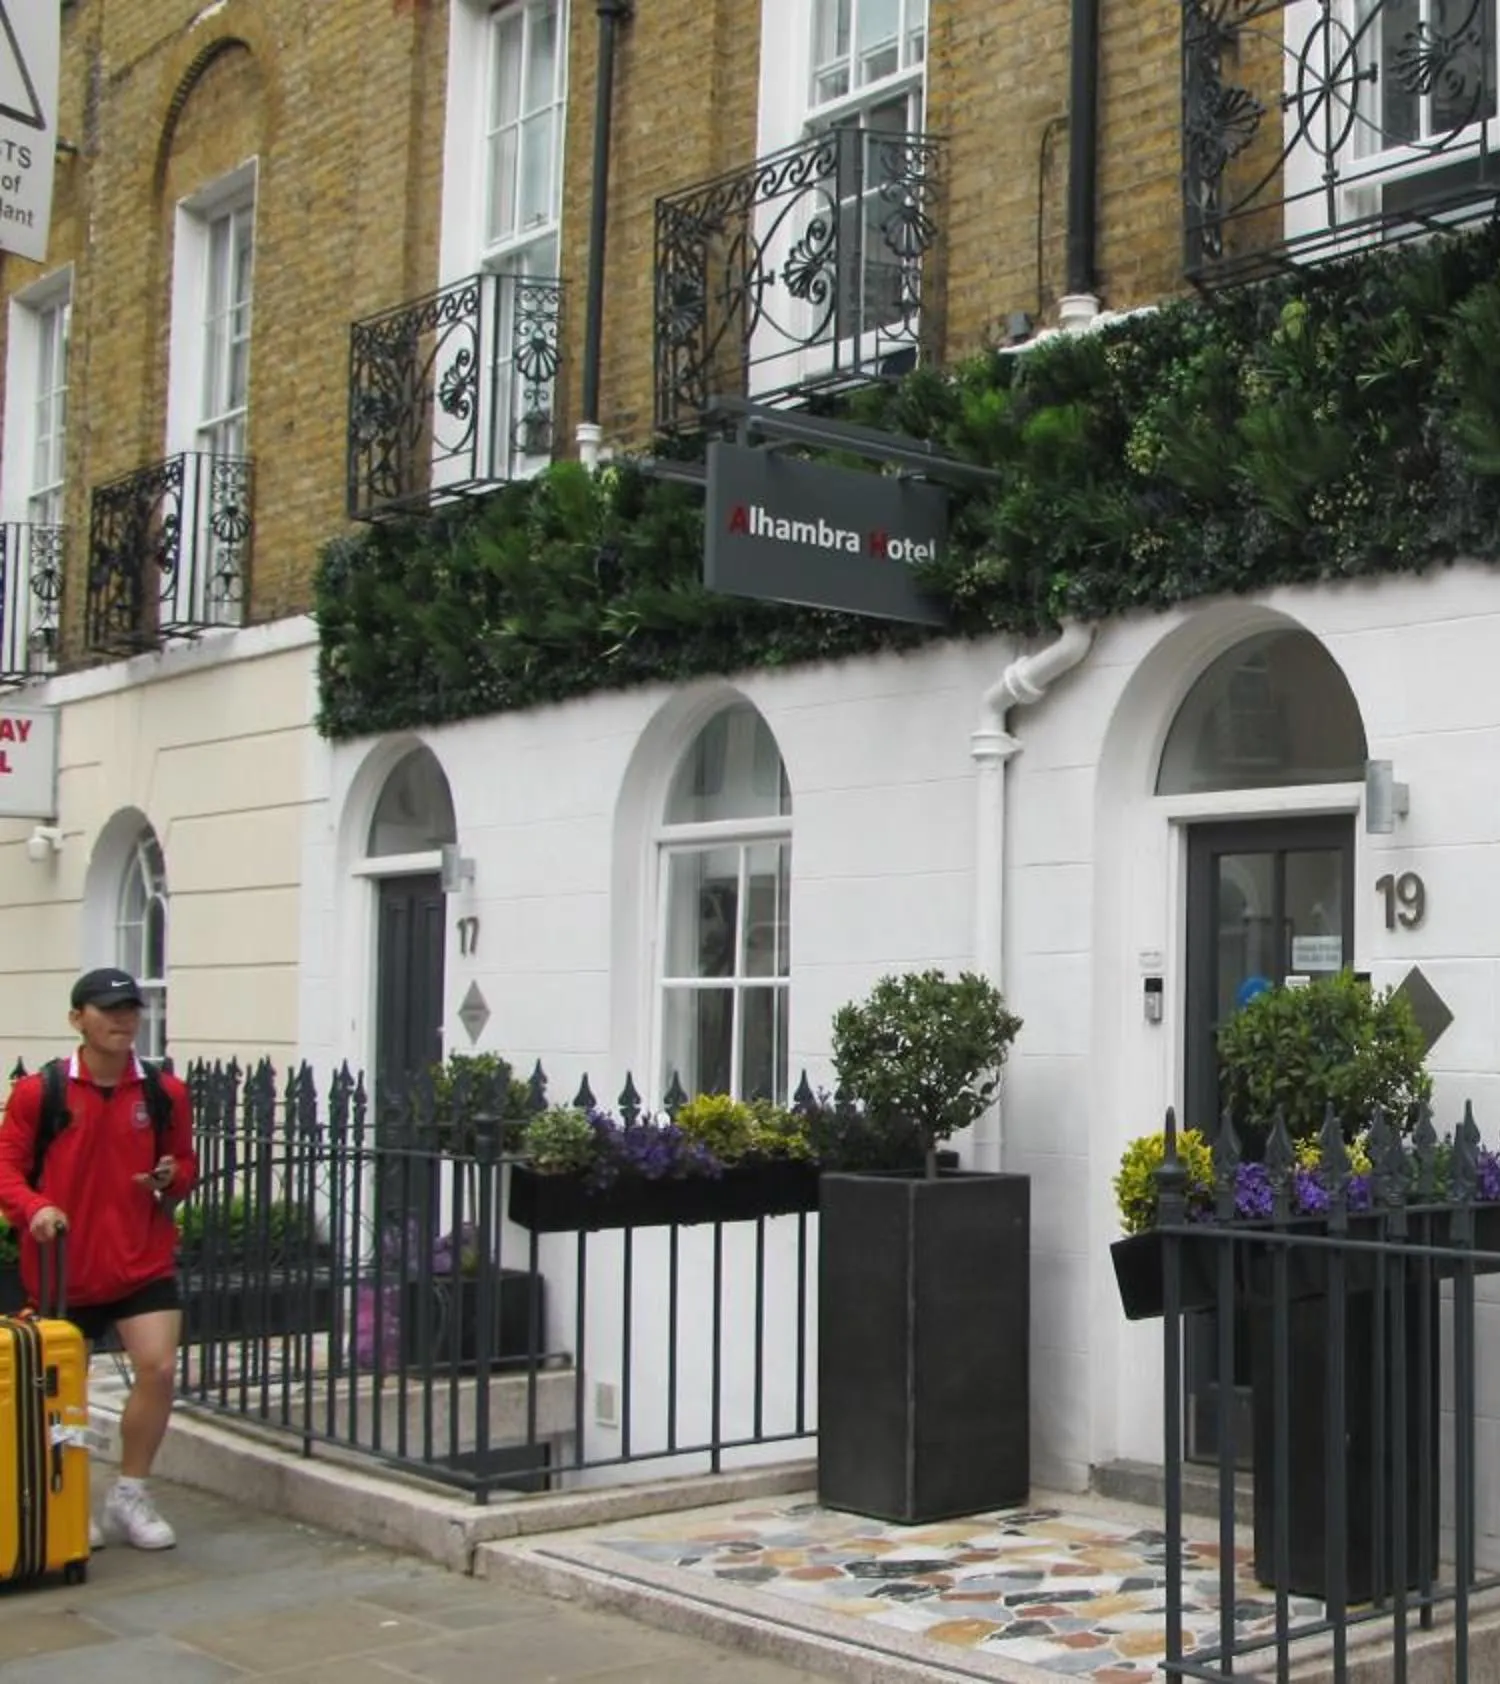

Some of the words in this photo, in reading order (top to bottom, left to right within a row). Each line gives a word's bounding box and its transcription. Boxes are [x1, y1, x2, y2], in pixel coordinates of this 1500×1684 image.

[0, 139, 32, 169] TS
[1, 175, 21, 194] of
[729, 504, 860, 553] Alhambra
[869, 530, 935, 563] Hotel
[1375, 872, 1426, 929] 19
[456, 916, 480, 955] 17
